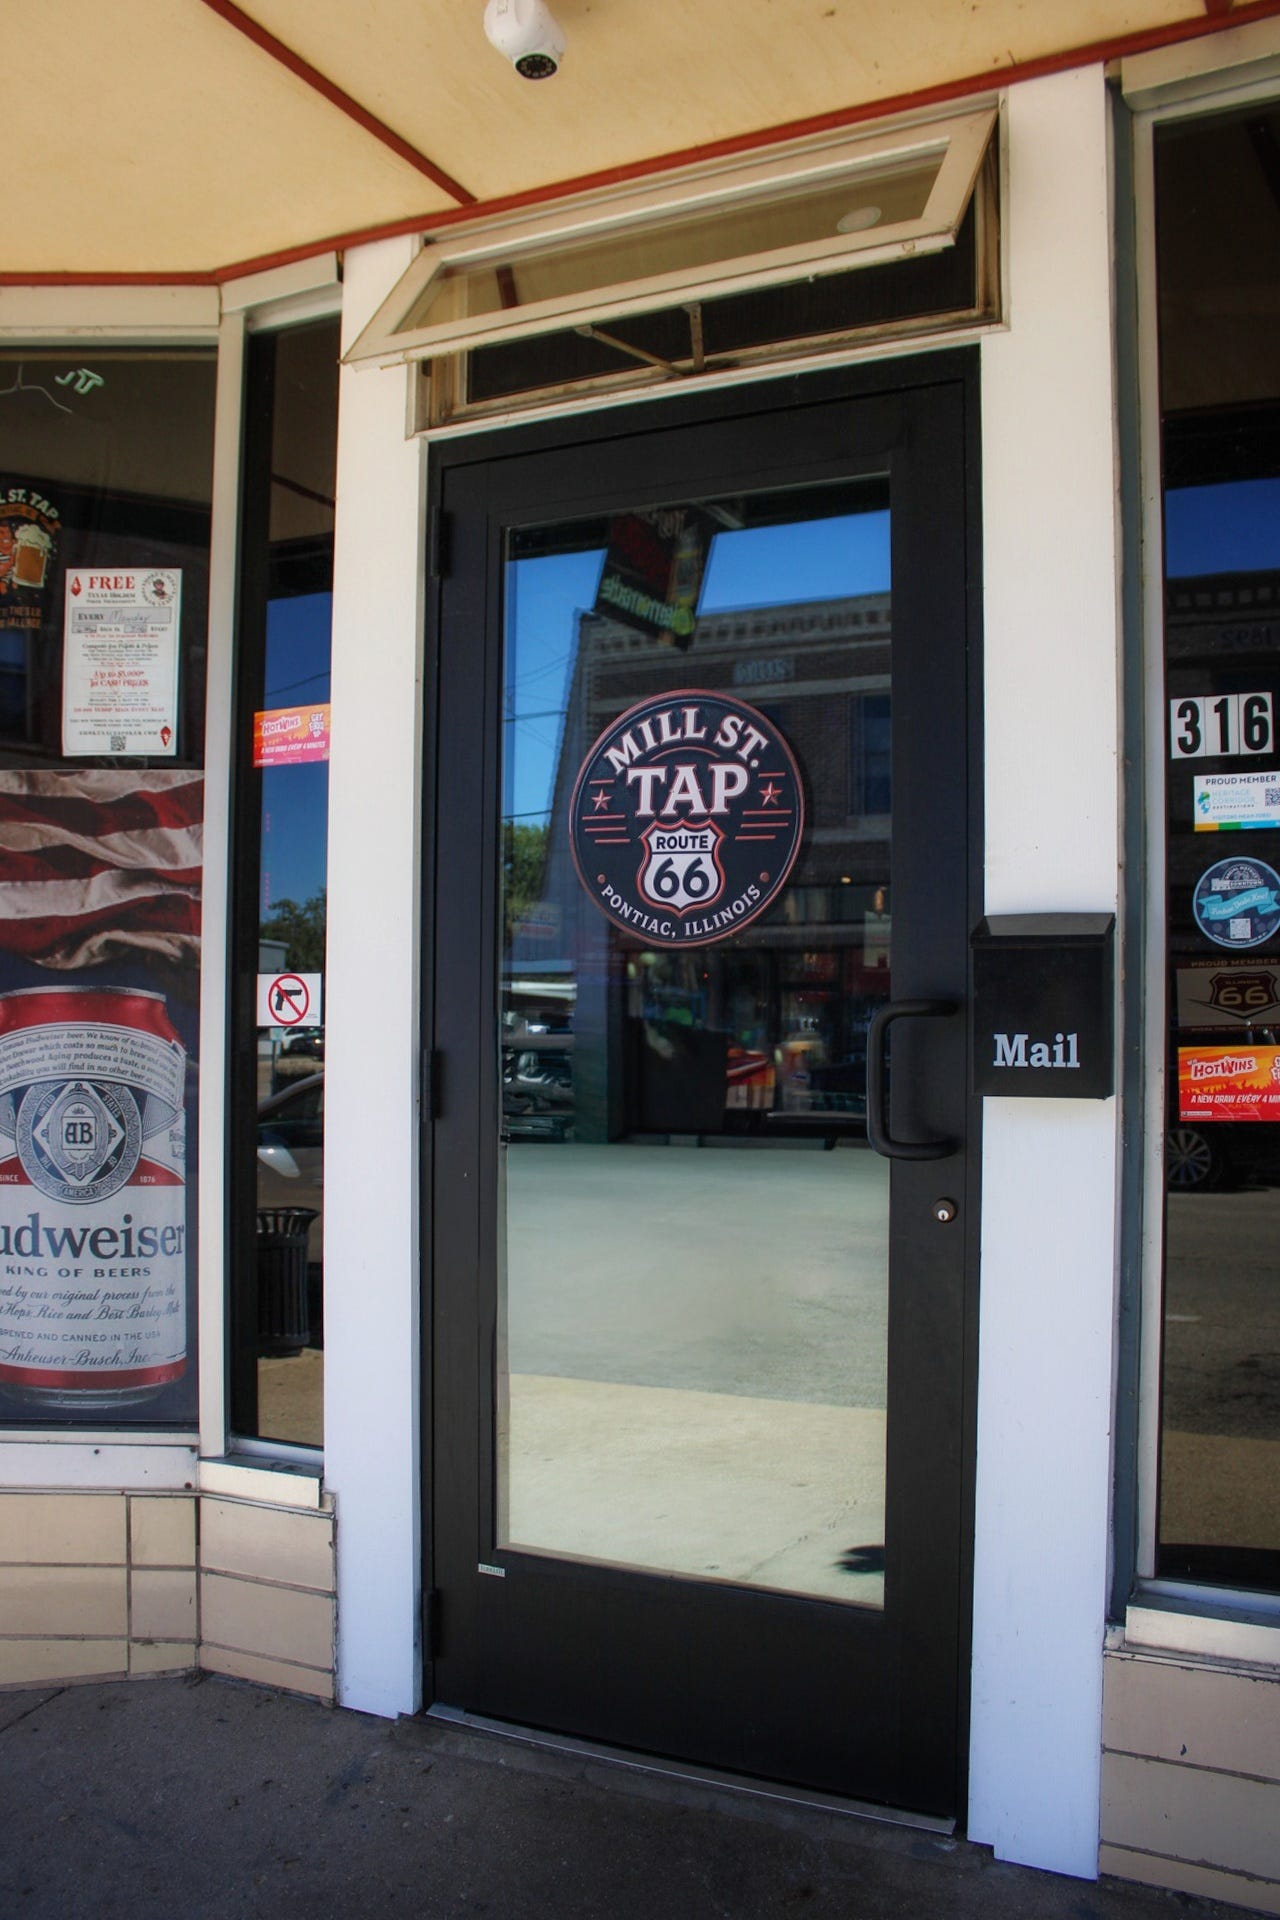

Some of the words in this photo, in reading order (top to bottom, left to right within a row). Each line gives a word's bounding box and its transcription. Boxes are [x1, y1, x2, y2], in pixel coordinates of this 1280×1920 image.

[8, 489, 26, 502] ST.
[30, 492, 59, 519] TAP
[88, 576, 136, 590] FREE
[1178, 695, 1270, 755] 316
[604, 707, 707, 775] MILL
[714, 715, 770, 768] ST.
[1205, 777, 1238, 785] PROUD
[1239, 774, 1277, 784] MEMBER
[627, 763, 749, 816] TAP
[656, 835, 709, 849] ROUTE
[653, 857, 710, 898] 66
[601, 884, 676, 938] PONTIAC,
[685, 884, 761, 936] ILLINOIS
[1231, 958, 1279, 966] MEMBER
[1218, 986, 1269, 1005] 66
[993, 1033, 1080, 1068] Mail
[68, 1062, 85, 1071] find
[1191, 1095, 1196, 1103] A
[1197, 1095, 1214, 1103] NEW
[1214, 1095, 1235, 1103] DRAW
[1236, 1094, 1261, 1103] EVERY
[1262, 1095, 1268, 1103] 4
[65, 1122, 94, 1144] AB
[6, 1266, 48, 1277] KING
[58, 1267, 84, 1278] OF
[94, 1266, 152, 1278] BEERS
[15, 1286, 28, 1304] by
[30, 1291, 48, 1300] our
[52, 1289, 101, 1308] original
[101, 1290, 140, 1304] process
[65, 1308, 92, 1320] and
[95, 1305, 125, 1320] Best
[37, 1332, 57, 1341] AND
[62, 1333, 107, 1342] CANNED
[110, 1333, 121, 1341] IN
[124, 1332, 142, 1340] THE
